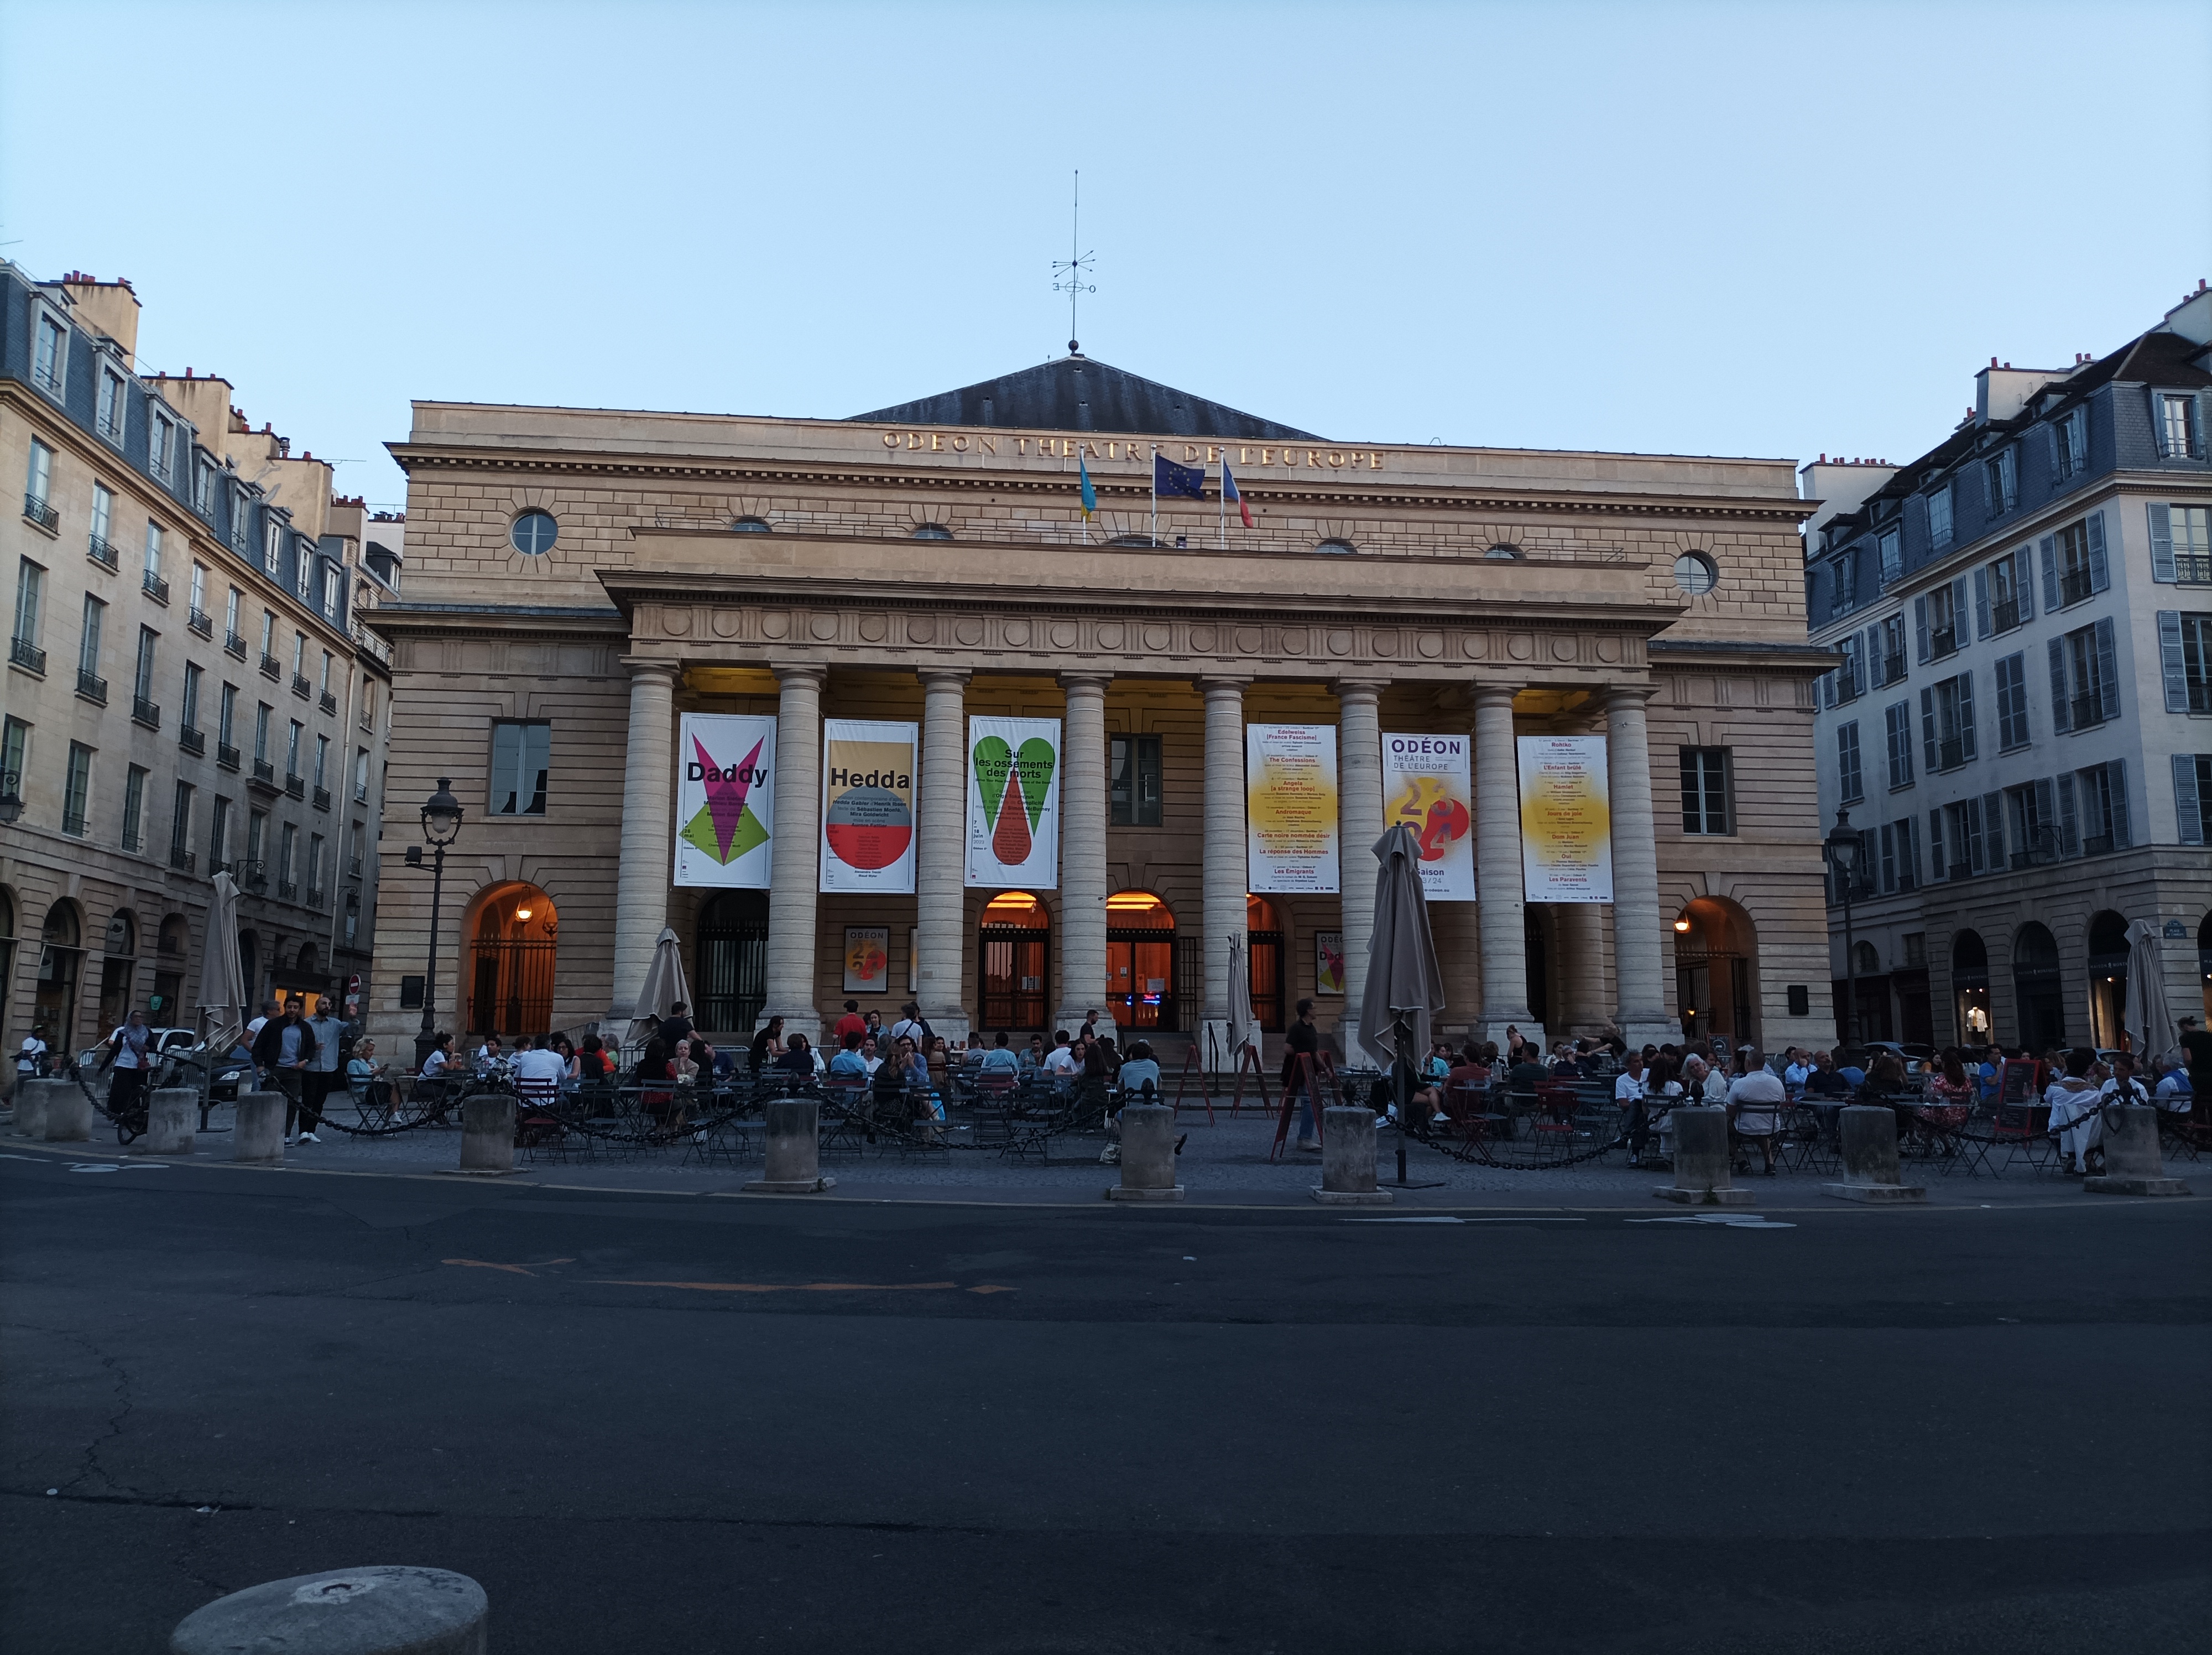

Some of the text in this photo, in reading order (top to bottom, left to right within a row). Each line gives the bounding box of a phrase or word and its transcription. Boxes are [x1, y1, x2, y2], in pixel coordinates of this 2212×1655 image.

[884, 431, 996, 455] ODEON
[1184, 445, 1220, 464] DE
[1240, 447, 1384, 470] L'EUROPE
[1391, 737, 1460, 754] ODÉON
[1004, 749, 1024, 758] Sur
[975, 757, 1053, 769] les ossements
[687, 762, 768, 788] Daddy
[831, 768, 910, 789] Hedda
[987, 768, 1041, 778] des morts
[850, 930, 884, 939] ODÉON
[1321, 935, 1343, 943] ODÉ
